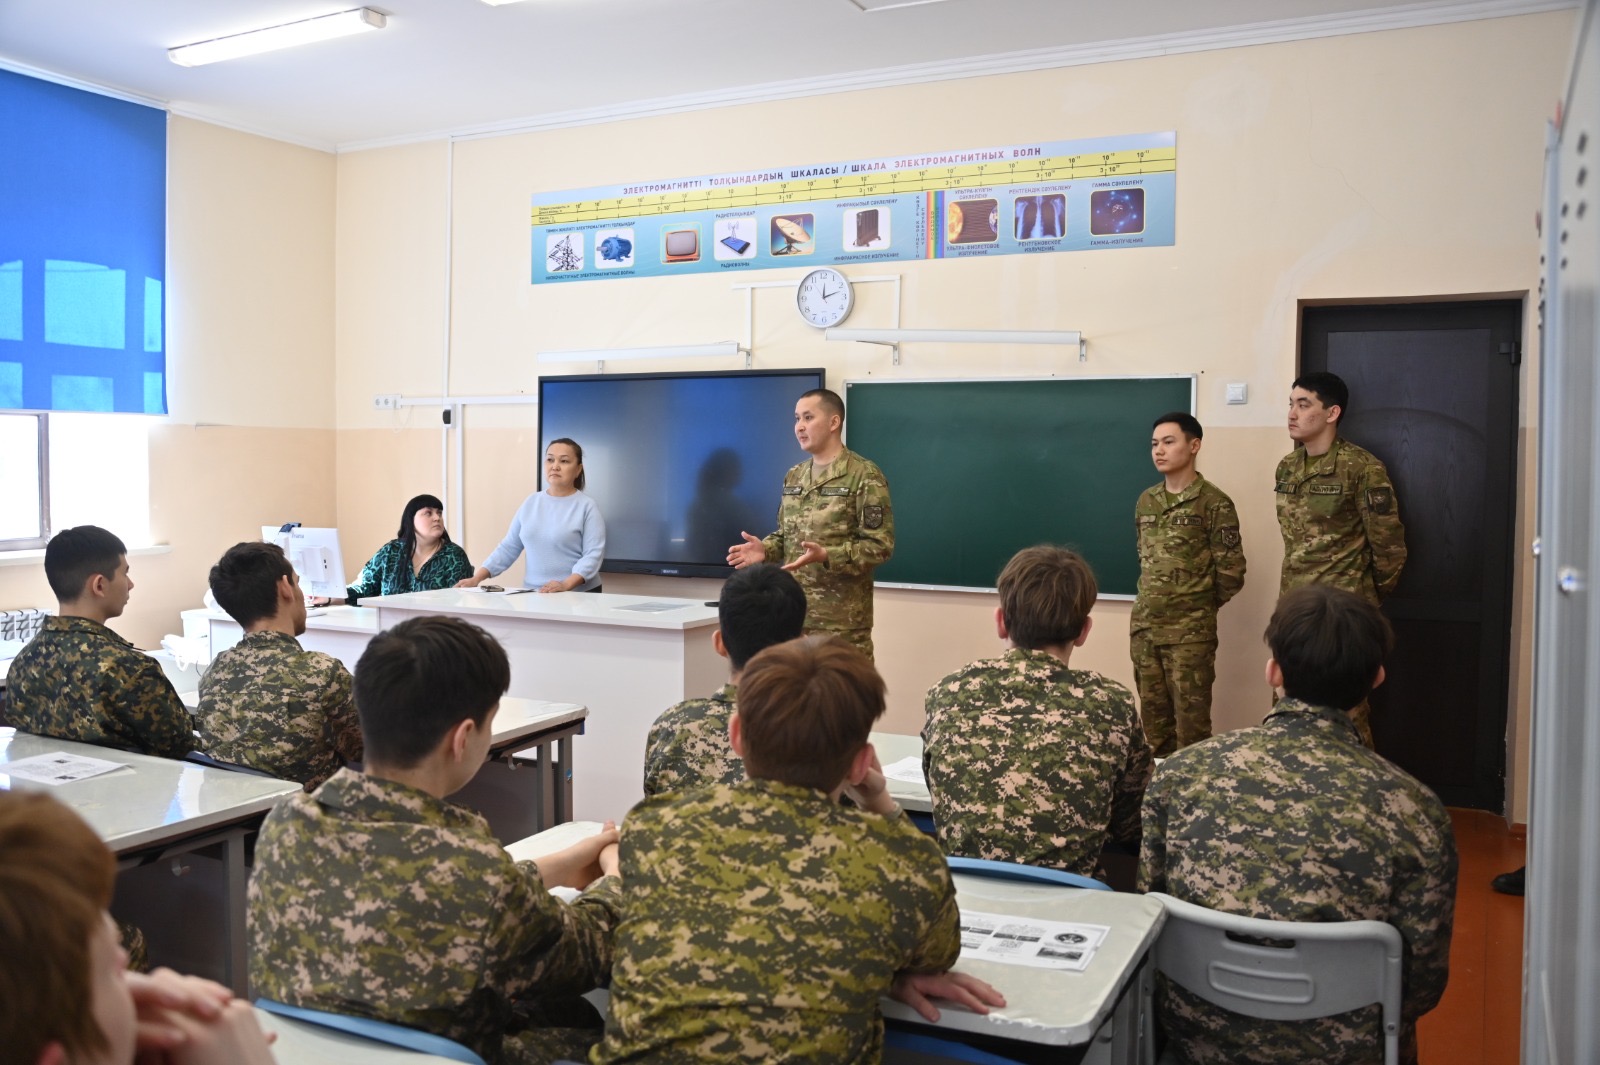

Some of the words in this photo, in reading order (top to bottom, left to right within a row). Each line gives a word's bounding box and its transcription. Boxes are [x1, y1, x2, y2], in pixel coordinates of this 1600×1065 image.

[623, 181, 702, 195] ЭЛЕКТРОМАГНИТТІ
[709, 172, 784, 186] ТОЛҚЫНДАРДЫҢ
[791, 166, 839, 178] ШКАЛАСЫ
[851, 162, 887, 172] ШКАЛА
[894, 151, 1004, 168] ЭЛЕКТРОМАГНИТНЫХ
[1013, 147, 1041, 158] ВОЛН
[1090, 238, 1144, 246] ГАММА-ИЗЛУЧЕНИЕ
